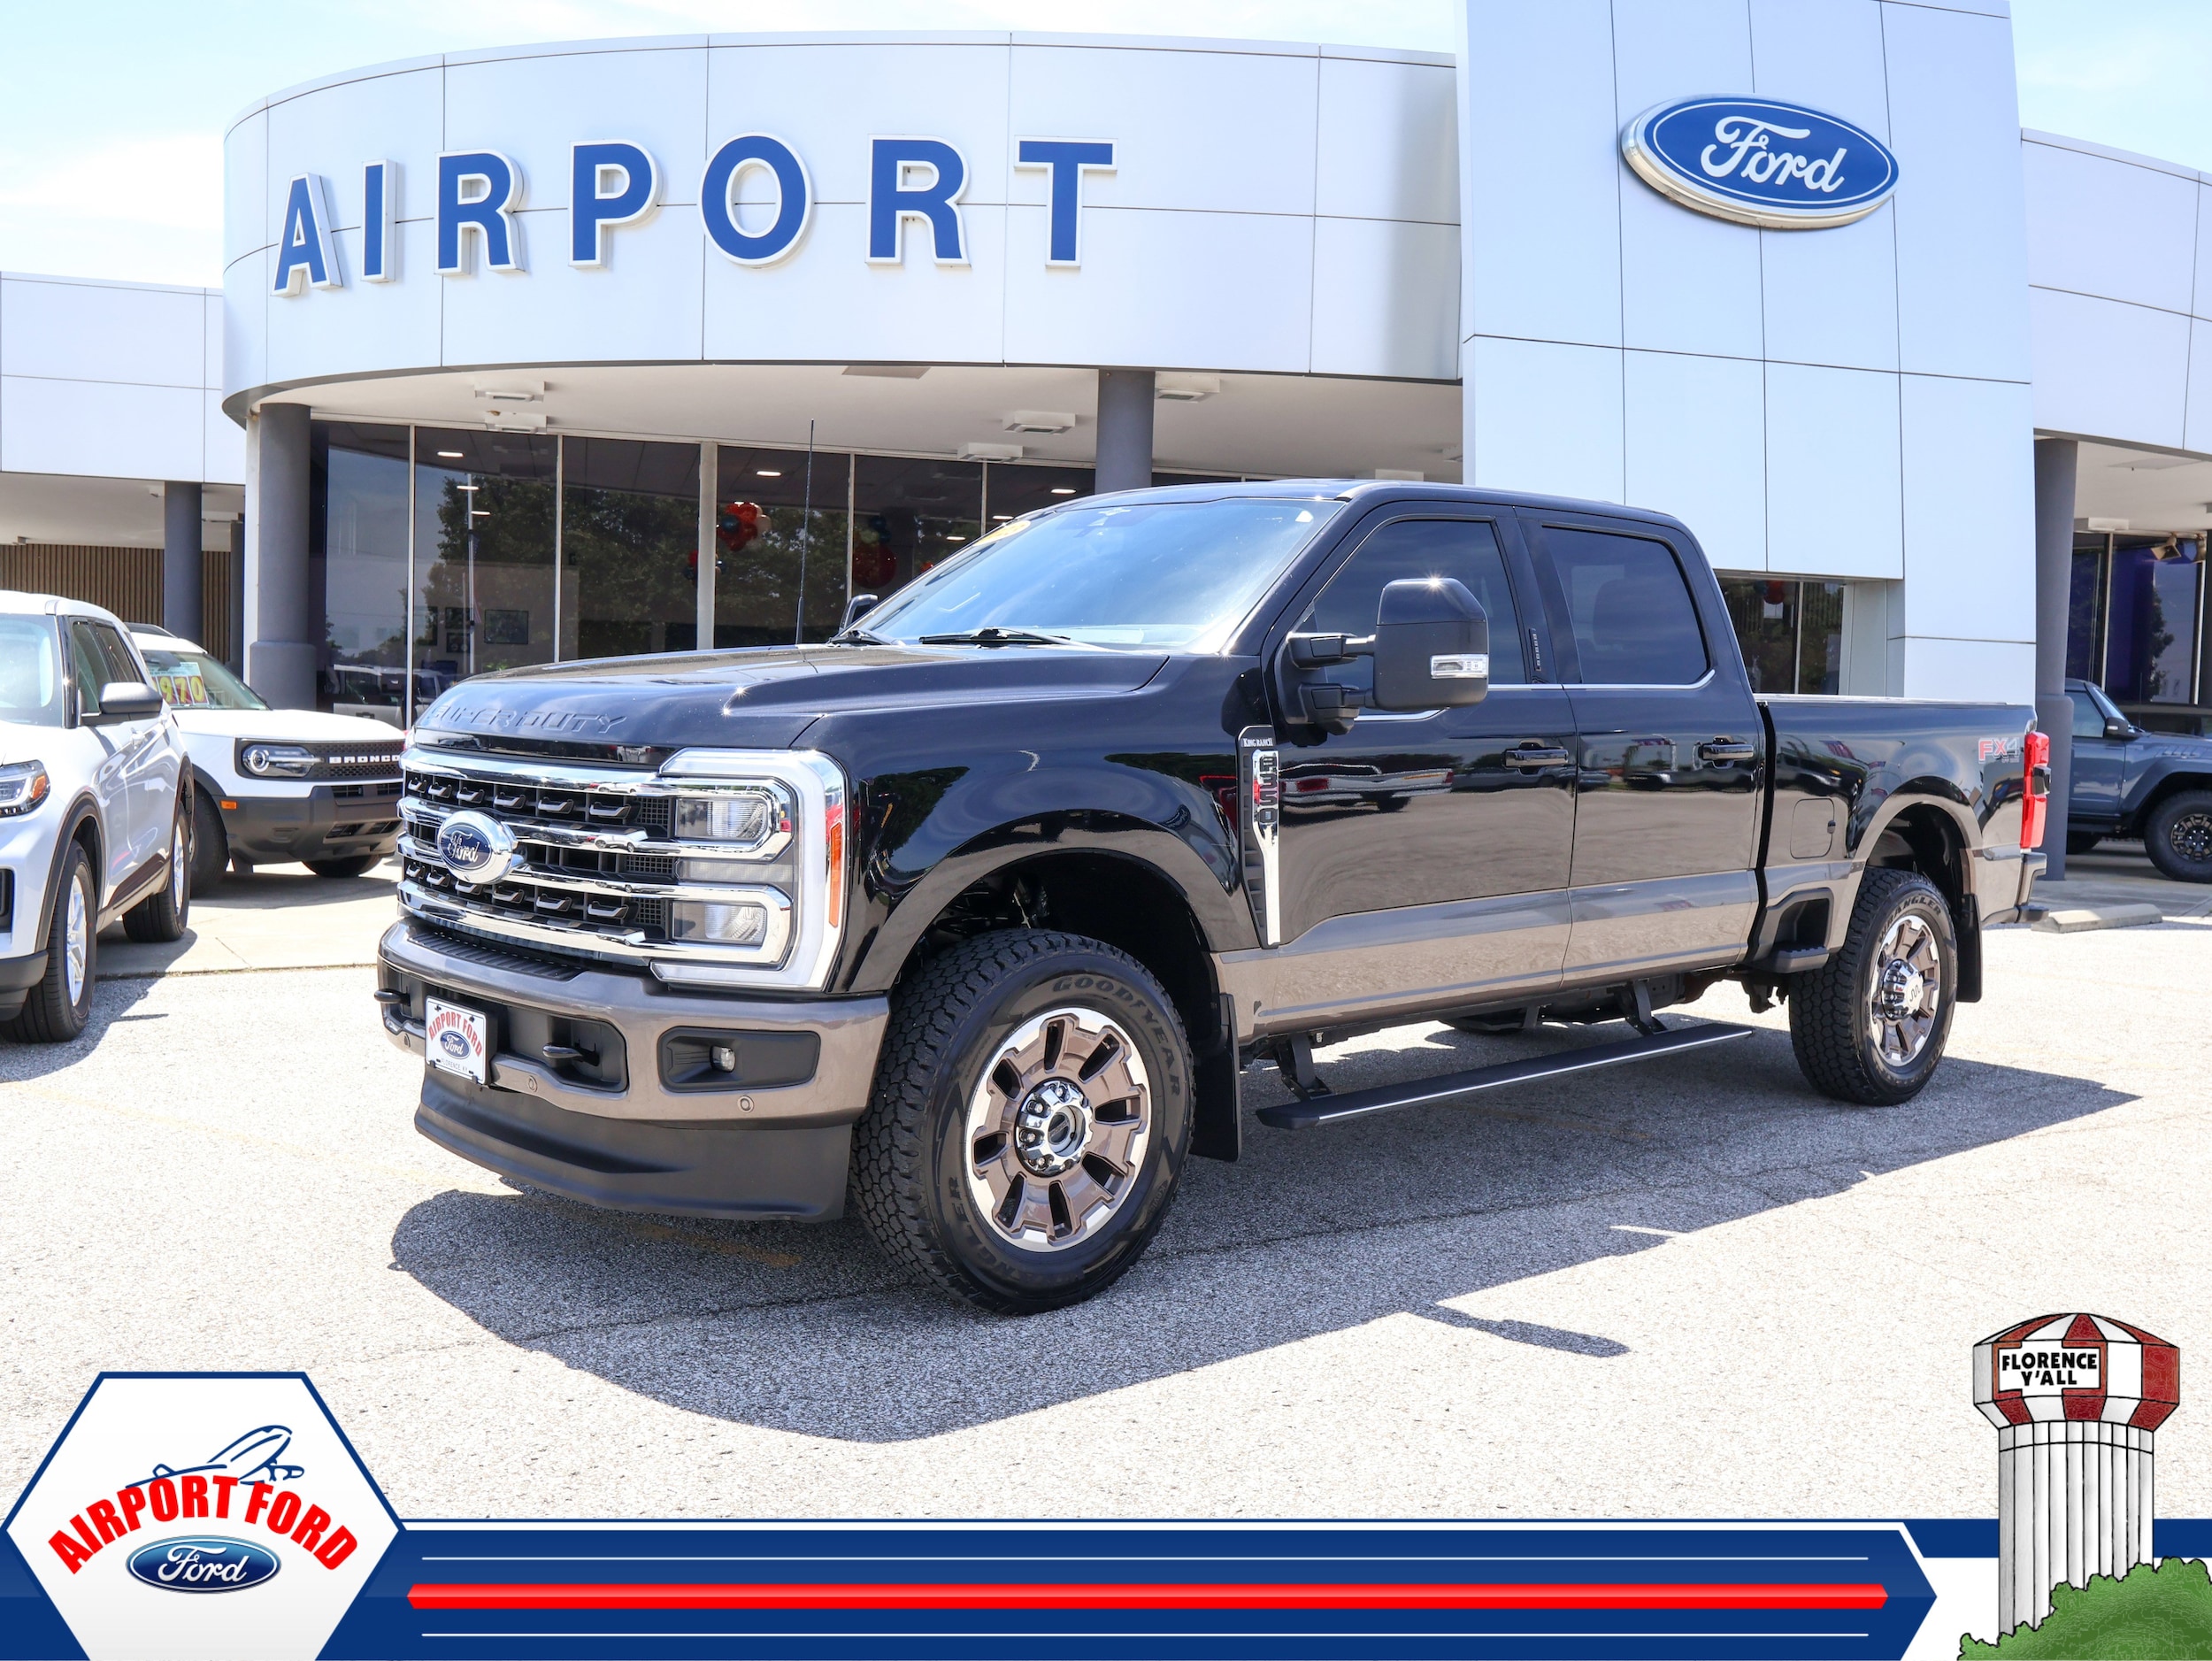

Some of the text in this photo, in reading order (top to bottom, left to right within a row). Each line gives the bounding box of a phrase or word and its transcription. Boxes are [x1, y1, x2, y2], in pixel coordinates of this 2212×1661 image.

[1700, 115, 1847, 193] Ford
[271, 132, 1118, 297] AIRPORT
[152, 676, 204, 703] 970
[427, 704, 627, 734] SUPER DUTY
[328, 754, 400, 764] BRONCO
[1978, 737, 2020, 765] FX4
[447, 830, 480, 863] Ford
[1878, 895, 1942, 943] WRANGLER
[428, 1011, 482, 1057] AIRPORT FORD
[444, 1034, 465, 1056] Ford
[1052, 976, 1181, 1096] GOODYEAR
